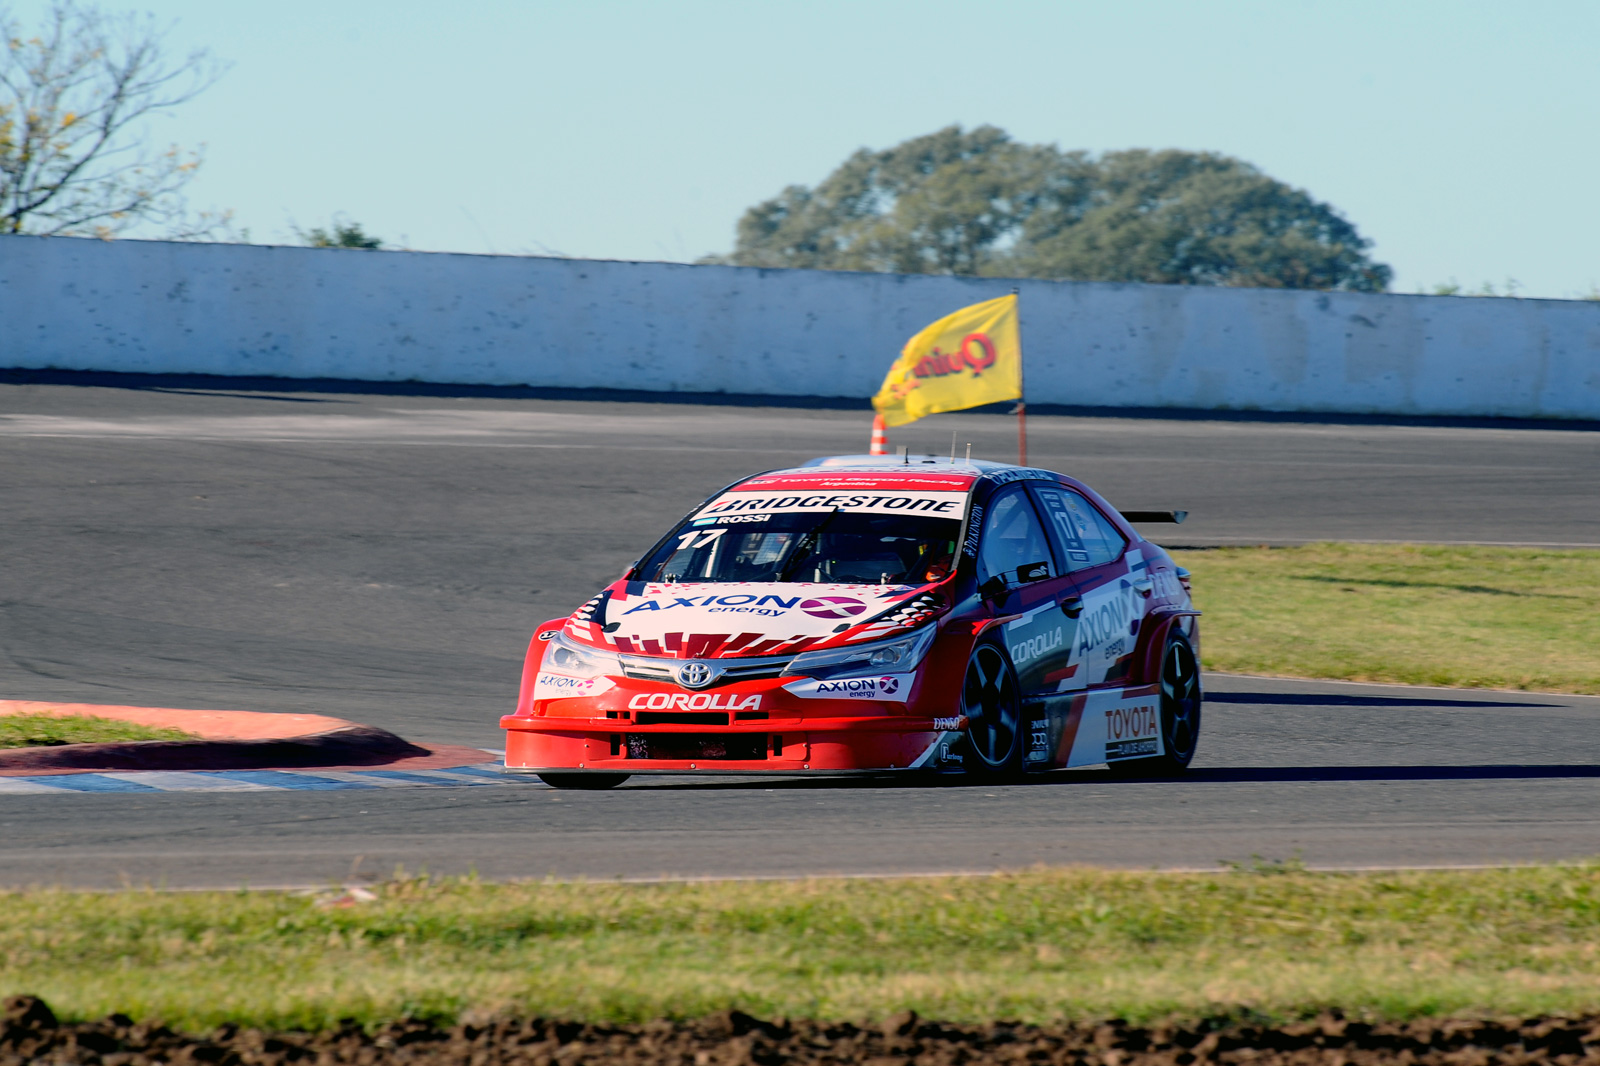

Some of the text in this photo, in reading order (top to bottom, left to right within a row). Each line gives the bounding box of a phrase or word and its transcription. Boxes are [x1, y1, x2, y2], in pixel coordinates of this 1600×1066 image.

[704, 495, 960, 514] BRIDGESTONE
[716, 514, 771, 525] ROSSI
[965, 503, 984, 552] PILKINGTON
[1054, 511, 1076, 540] 17
[676, 528, 729, 550] 17
[622, 594, 802, 615] AXION
[708, 606, 786, 617] energy
[1078, 598, 1124, 657] AXION
[1011, 626, 1063, 665] COROLLA
[540, 675, 579, 687] AXION
[816, 678, 876, 693] AXION
[628, 694, 763, 711] COROLLA
[848, 689, 876, 698] energy
[933, 717, 960, 730] DENSO
[1105, 706, 1158, 740] TOYOTA
